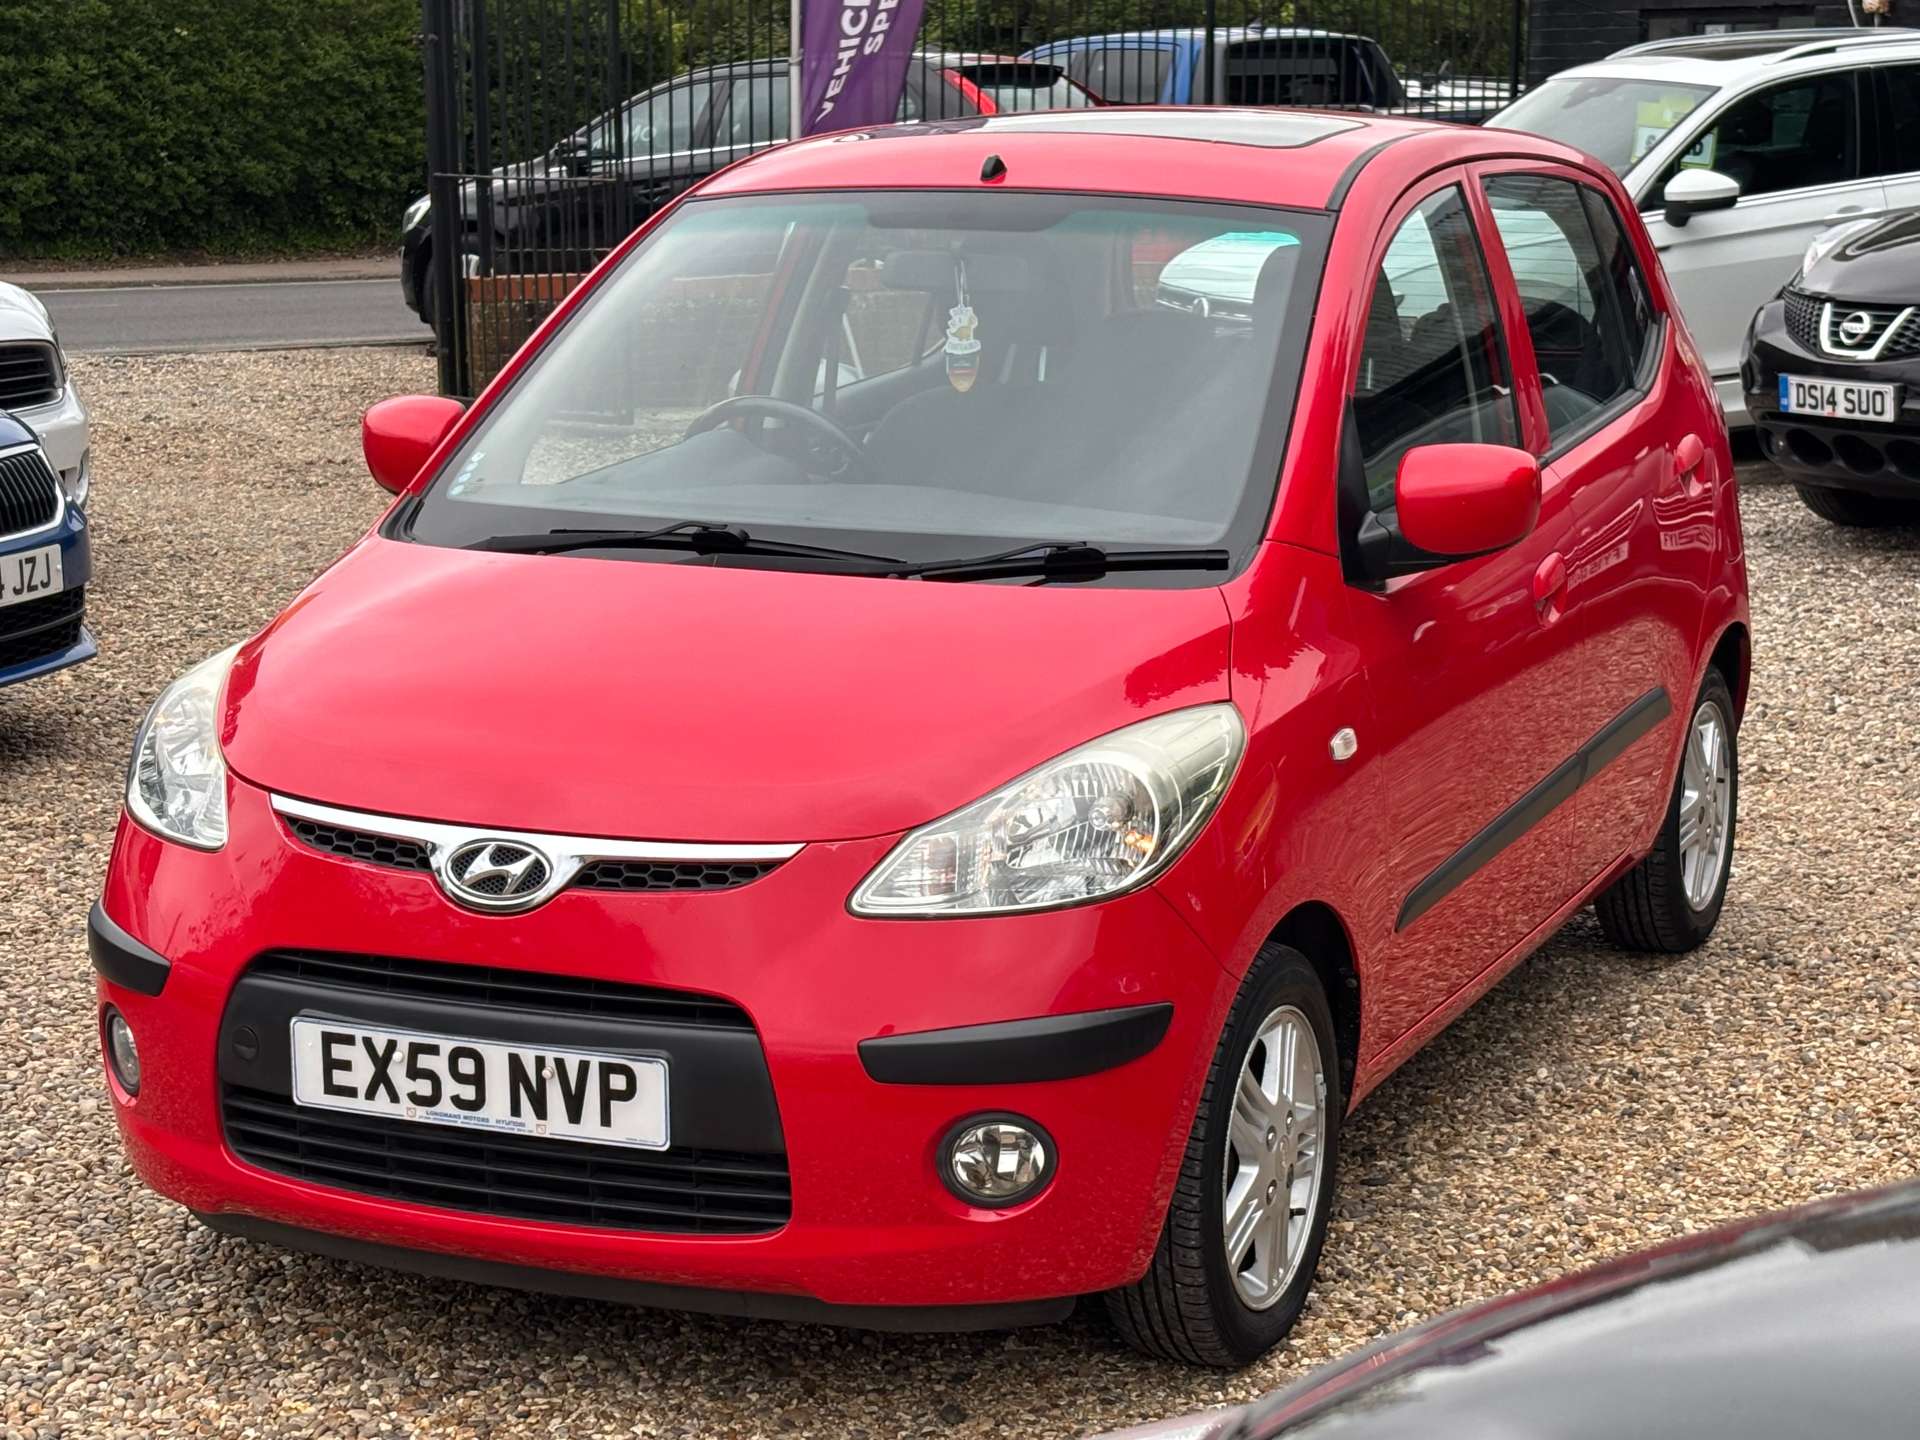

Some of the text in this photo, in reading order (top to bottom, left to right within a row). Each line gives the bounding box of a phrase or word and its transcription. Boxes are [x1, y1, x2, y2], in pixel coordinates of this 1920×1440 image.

[1795, 383, 1885, 417] DS14 SUO
[12, 552, 51, 596] JZJ
[320, 1030, 638, 1129] EX59 NVP
